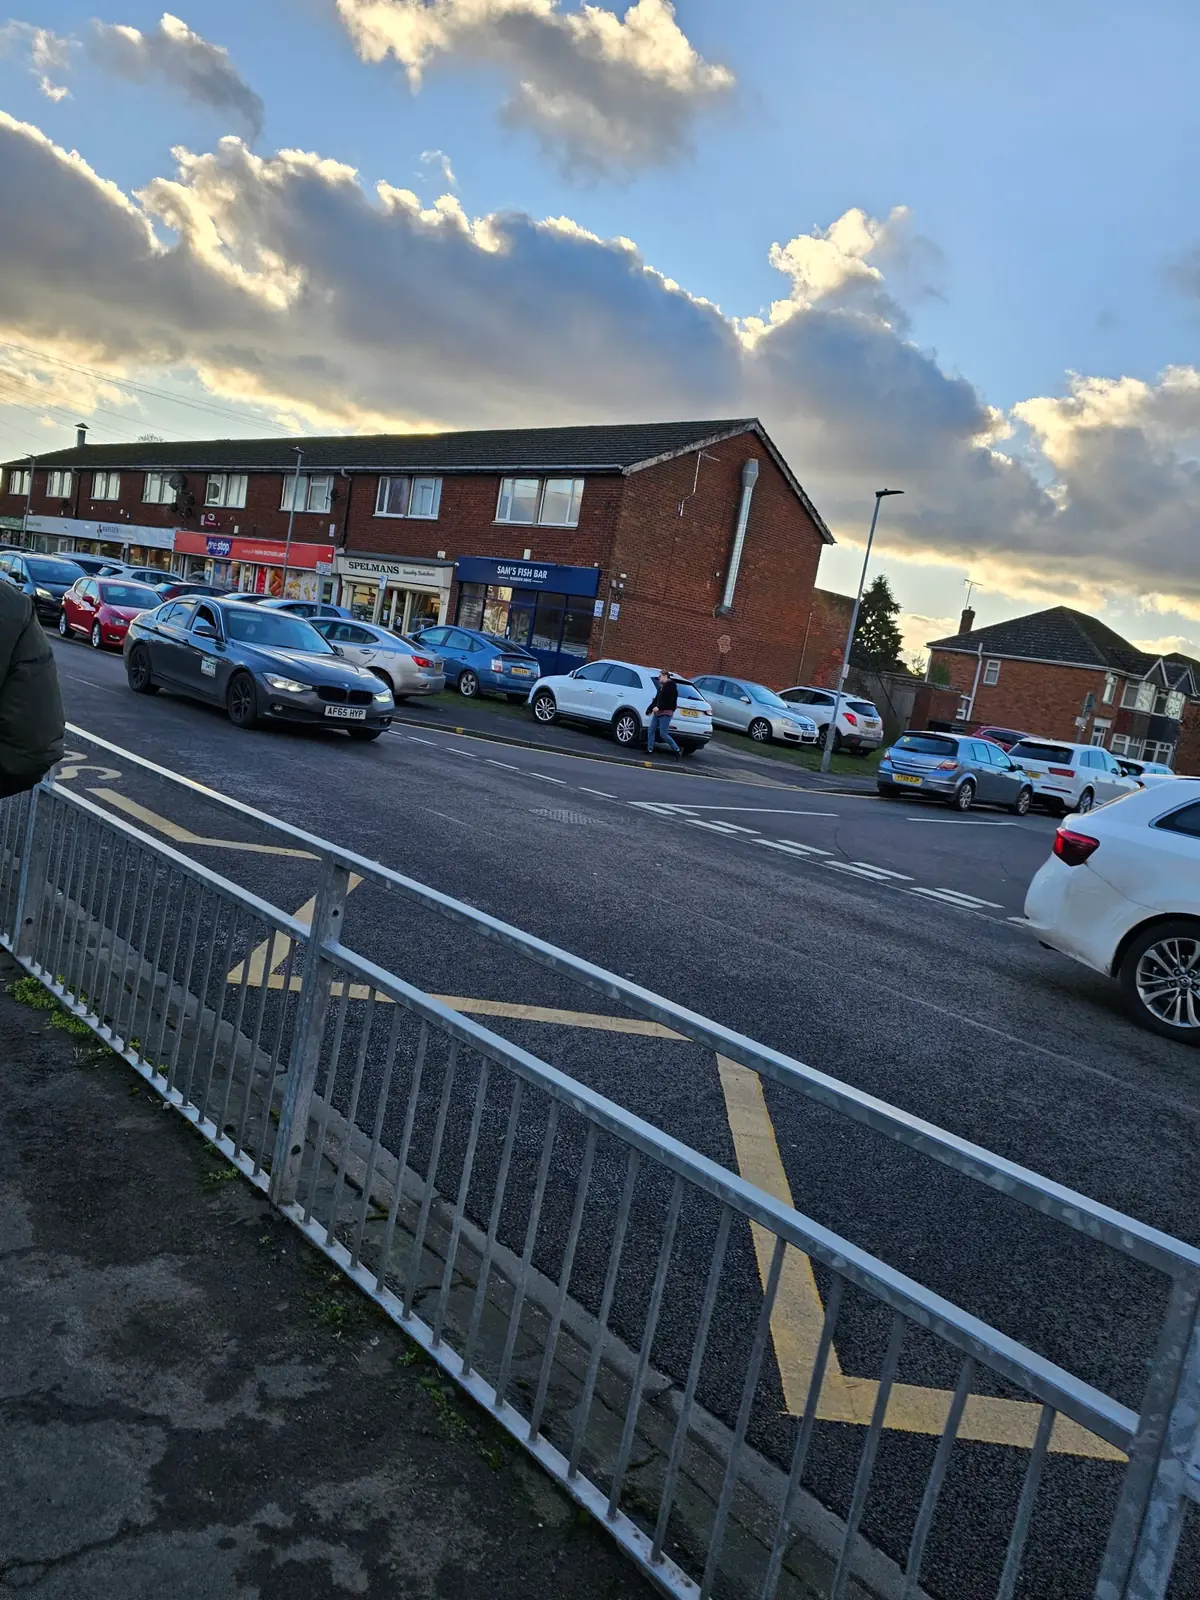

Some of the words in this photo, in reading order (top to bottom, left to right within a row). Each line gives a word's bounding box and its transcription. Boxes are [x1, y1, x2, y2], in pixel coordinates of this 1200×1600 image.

[216, 540, 230, 554] stop
[348, 561, 399, 574] SPELMANS
[497, 565, 516, 575] SAM'S
[517, 568, 533, 577] FISH
[533, 569, 548, 579] BAR
[327, 707, 348, 717] AF65
[349, 709, 364, 718] HYP
